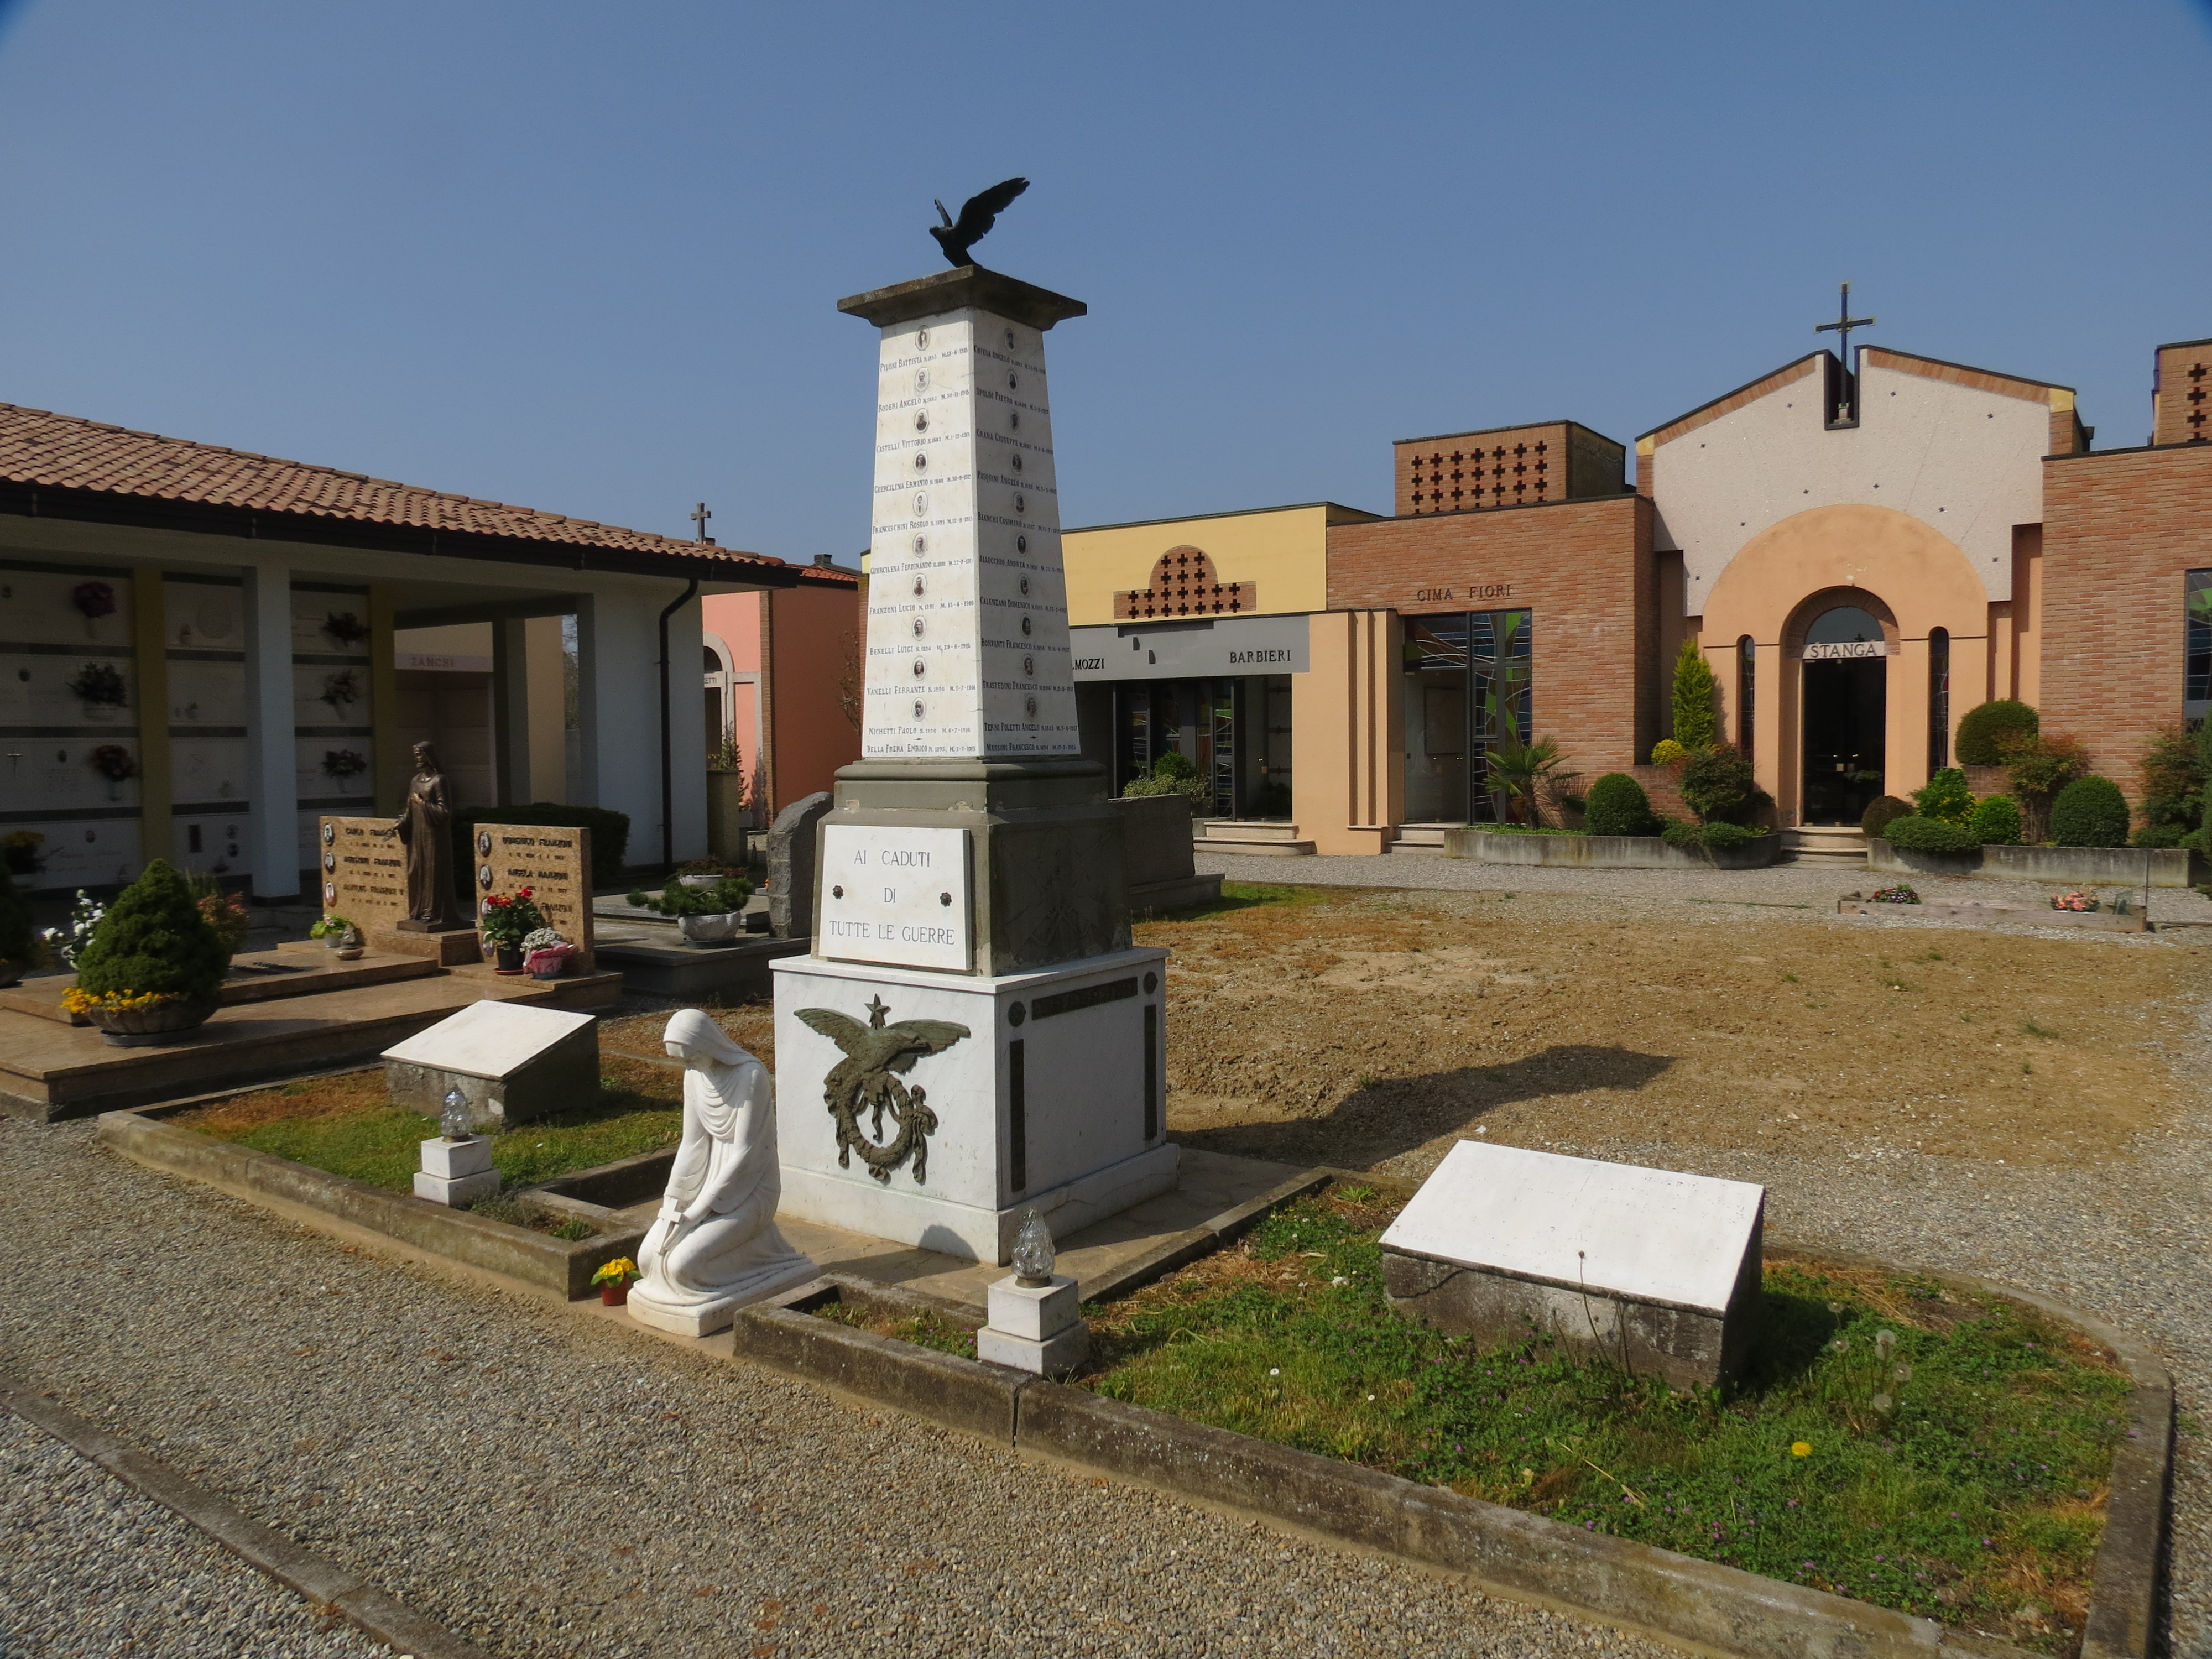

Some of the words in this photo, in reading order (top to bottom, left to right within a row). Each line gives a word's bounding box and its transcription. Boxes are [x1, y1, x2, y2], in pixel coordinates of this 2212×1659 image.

[993, 351, 1010, 363] ANGELO
[880, 362, 897, 372] PILONI
[899, 357, 922, 367] BATTISTA
[976, 387, 993, 399] SPOLDI
[995, 392, 1013, 404] PIETRO
[878, 403, 898, 413] RODERI
[899, 398, 921, 408] ANGELO
[995, 432, 1019, 446] GIUSEPPE
[876, 442, 899, 453] CASTELLI
[902, 438, 926, 448] VITTORIO
[906, 479, 928, 488] ERMINIO
[1000, 476, 1019, 487] ANGELO
[978, 512, 998, 523] BIANCHI
[999, 516, 1022, 527] CASIMIRO
[872, 523, 908, 534] FRANCESCHINI
[910, 520, 928, 529] ROSOLO
[901, 561, 931, 571] FERDINANDO
[979, 555, 1005, 565] ALLOCCHIO
[1007, 559, 1025, 568] ANDREA
[1417, 588, 1453, 602] CIMA
[1469, 584, 1511, 598] FIORI
[869, 606, 897, 615] FRANZONI
[899, 604, 916, 613] LUCIO
[1008, 599, 1030, 609] DOMENICO
[869, 647, 894, 655] BENELLI
[897, 645, 913, 654] LUIGI
[981, 638, 1005, 648] BONFANTI
[1006, 640, 1032, 650] FRANCESCO
[1229, 649, 1291, 664] BARBIERI
[1810, 643, 1877, 658] STANGA
[1072, 658, 1105, 670] MOZZI
[894, 686, 925, 694] FERRANTE
[982, 680, 1011, 690] TRASPEDINI
[1013, 681, 1038, 690] FRANCESCO
[868, 727, 896, 735] NICHETTI
[898, 726, 917, 734] PAOLO
[984, 723, 1000, 731] TERNI
[1001, 723, 1020, 731] POLETTI
[1022, 723, 1040, 731] ANGELO
[886, 744, 904, 753] FRERA
[907, 744, 927, 752] ENRICO
[854, 849, 867, 864] AI
[881, 850, 930, 867] CADUTI
[884, 888, 896, 904] DI
[829, 920, 871, 938] TUTTE
[878, 924, 895, 940] LE
[902, 926, 955, 945] GUERRE
